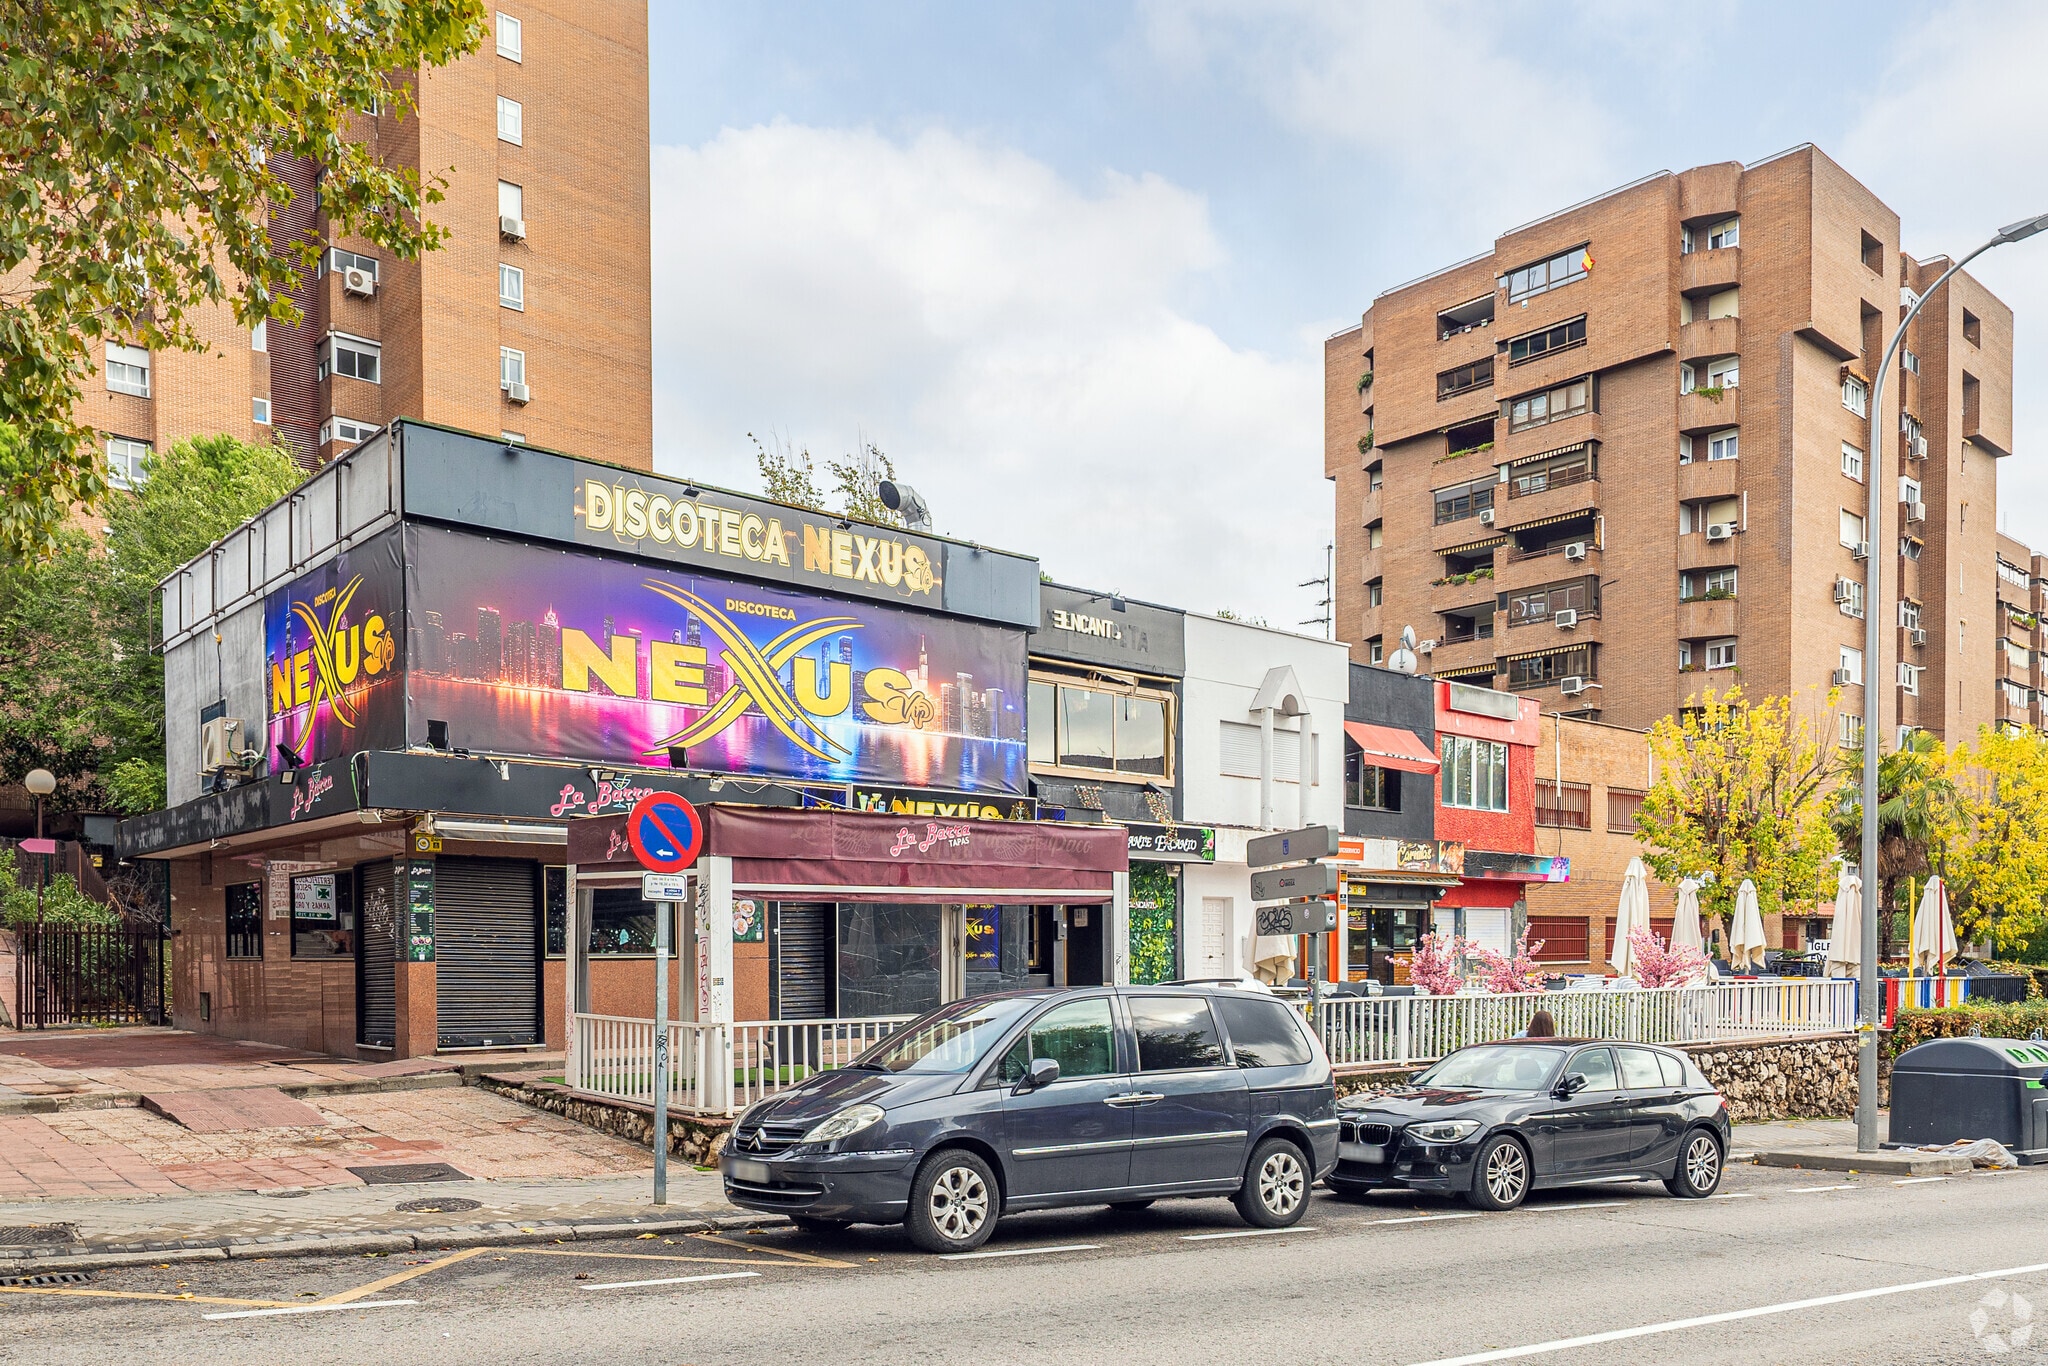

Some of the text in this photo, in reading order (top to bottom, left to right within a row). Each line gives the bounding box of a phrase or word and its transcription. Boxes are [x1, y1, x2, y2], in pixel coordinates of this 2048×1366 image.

[585, 479, 927, 593] DISCOTECA NEXUS
[314, 586, 337, 607] DISCOTECA
[725, 598, 797, 622] DISCOTECA
[271, 574, 386, 753] NEXUS
[561, 579, 912, 763] NEXUS
[291, 775, 334, 821] La Barra
[551, 781, 654, 816] La Barra
[890, 827, 917, 857] La
[919, 822, 971, 853] Barra
[949, 836, 970, 848] TAPAS
